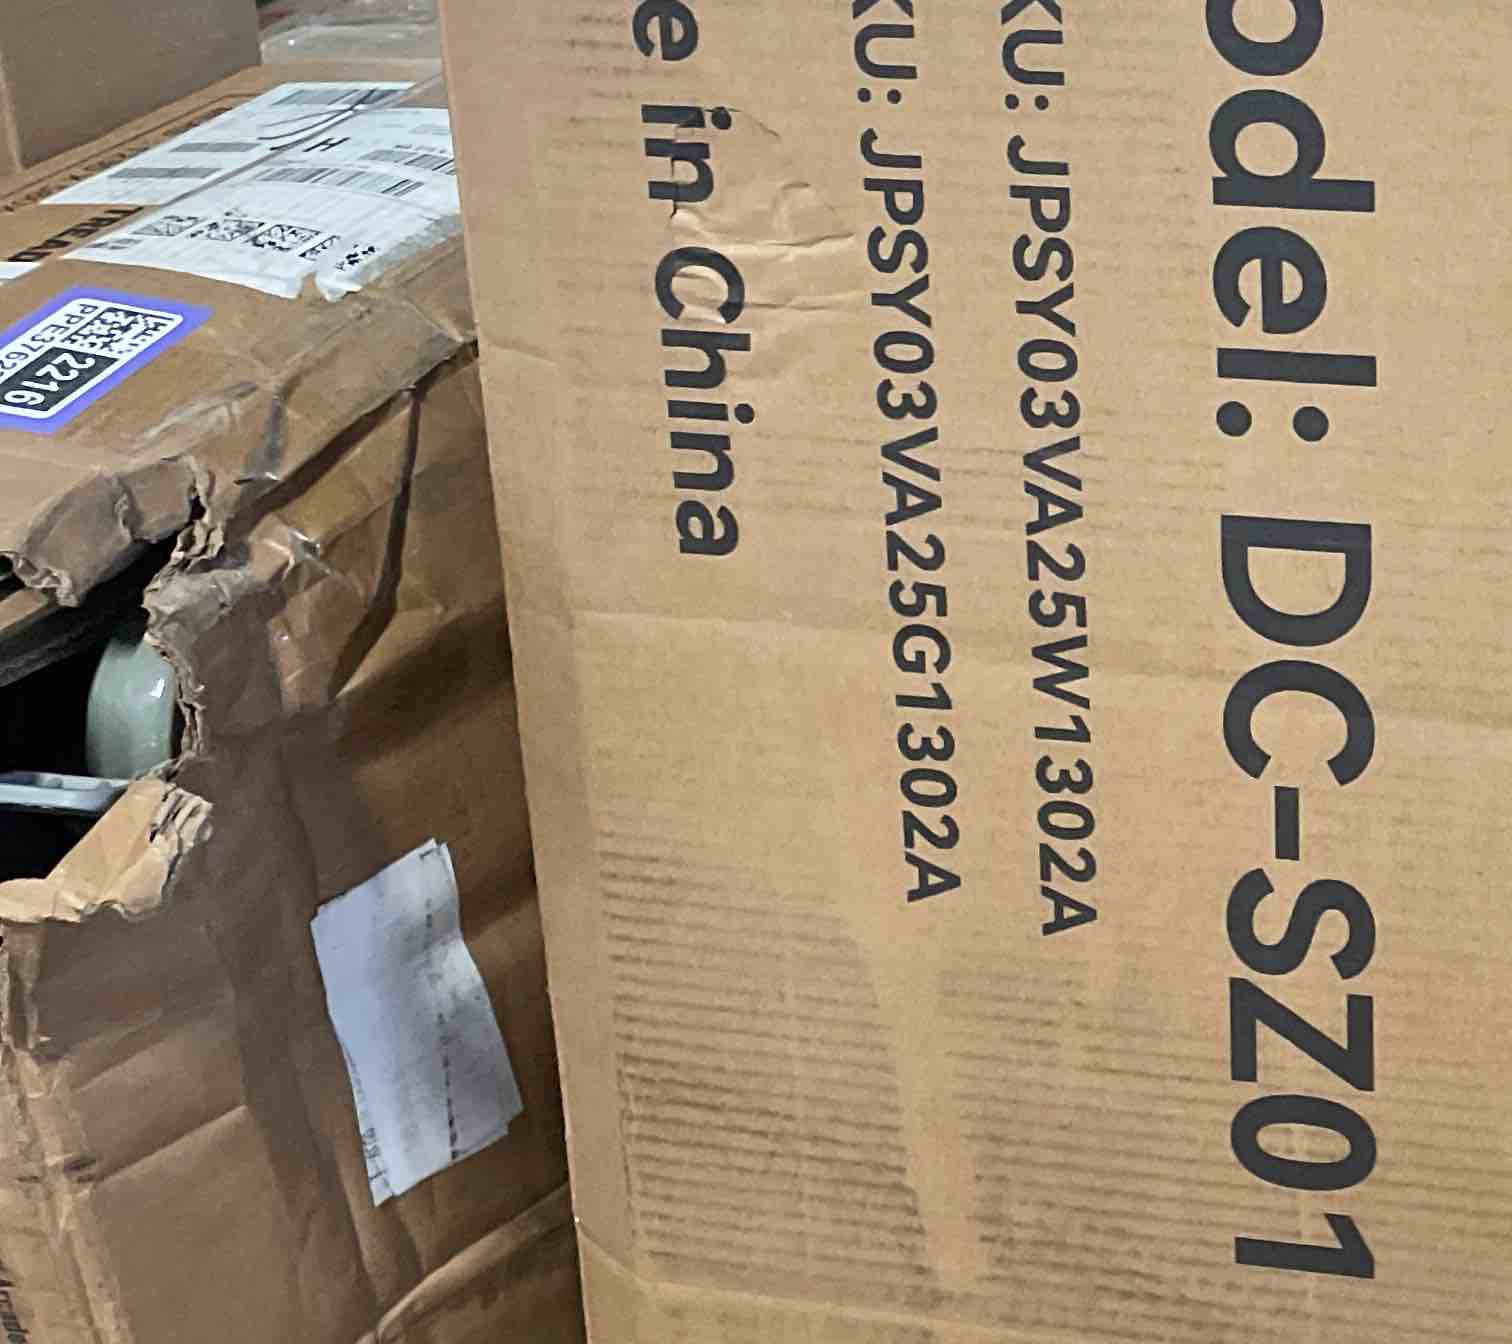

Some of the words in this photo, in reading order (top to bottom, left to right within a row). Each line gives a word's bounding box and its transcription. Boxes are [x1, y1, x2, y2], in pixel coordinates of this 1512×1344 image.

[3, 351, 96, 406] 2216
[640, 103, 732, 204] in
[654, 246, 756, 557] China
[859, 127, 962, 903] JPSY03VA25G1302A
[1006, 134, 1098, 937] JPSY03VA25W1302A
[1221, 514, 1377, 1279] DC-SZ01
